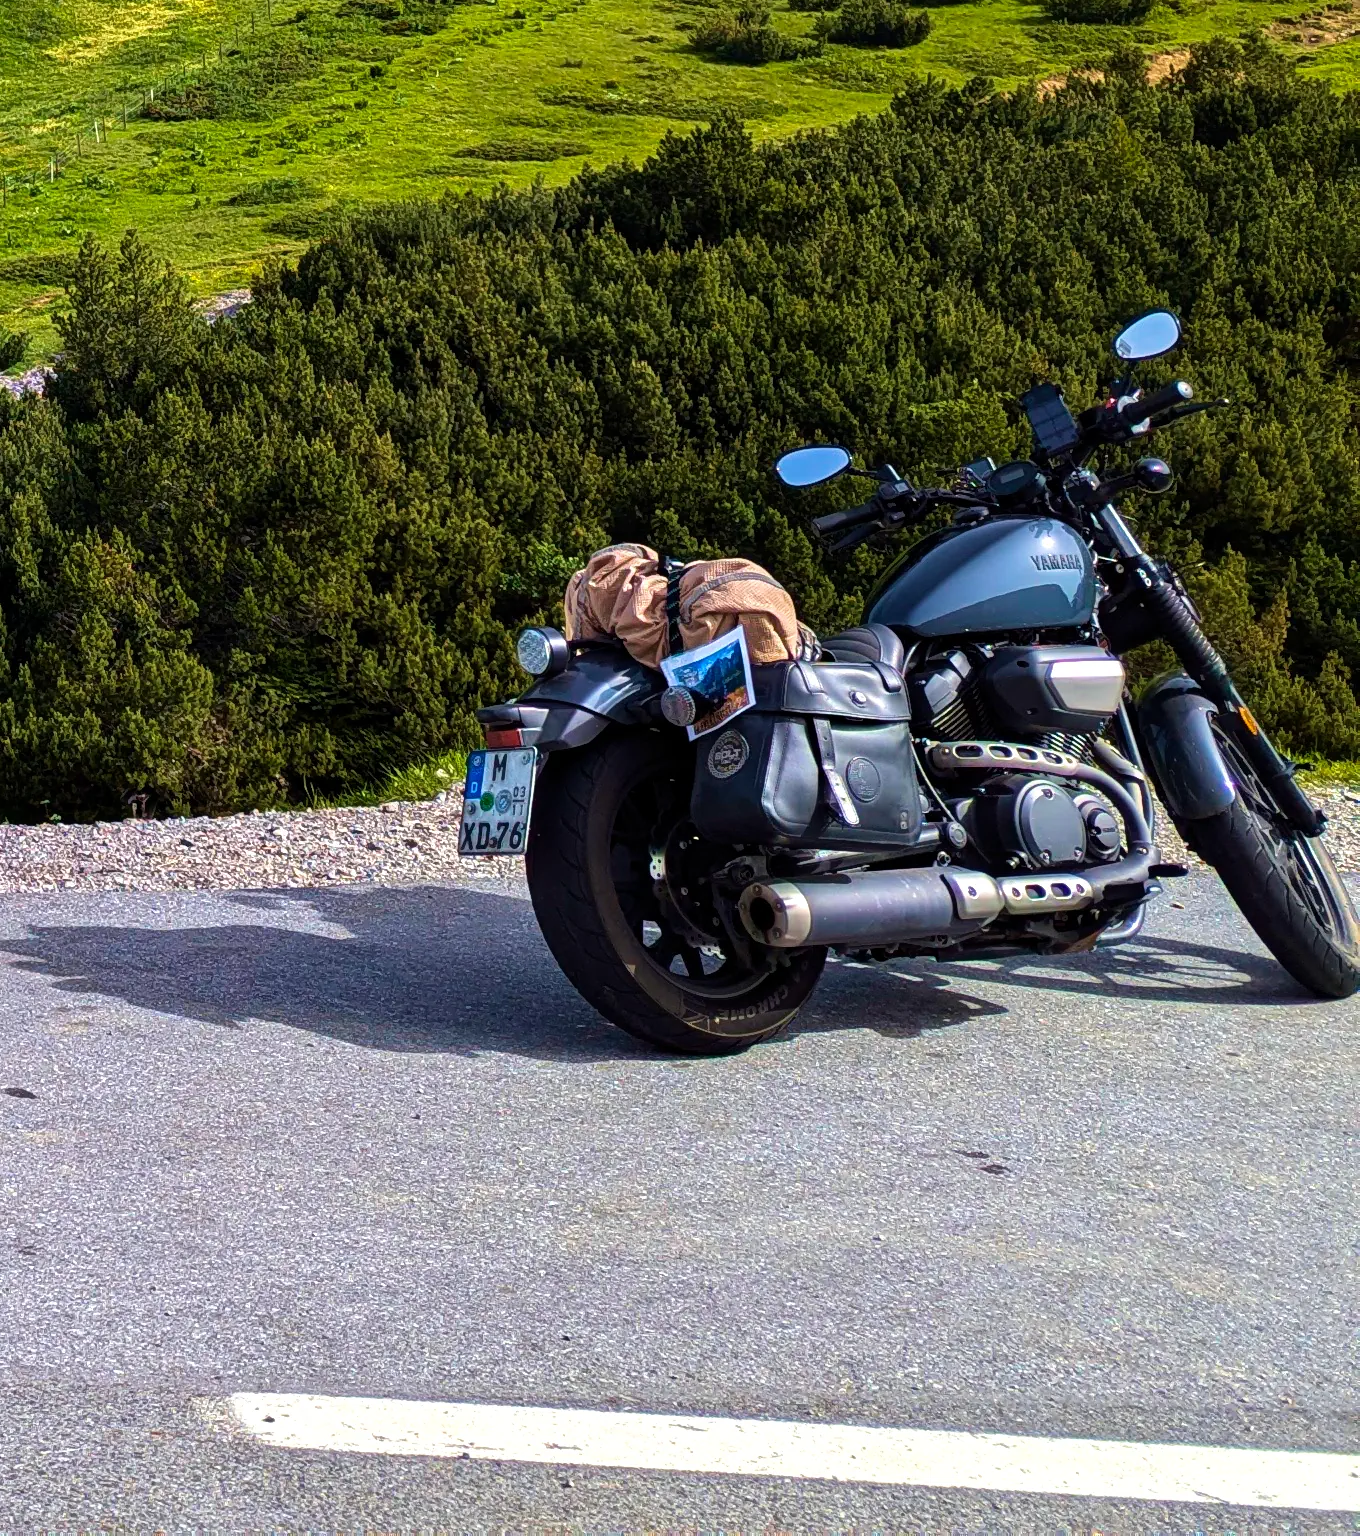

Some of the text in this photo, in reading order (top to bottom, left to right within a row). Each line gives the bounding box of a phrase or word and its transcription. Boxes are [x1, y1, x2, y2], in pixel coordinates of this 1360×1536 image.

[1030, 554, 1082, 571] YAMAHA
[492, 753, 508, 781] M
[460, 822, 491, 851] XD
